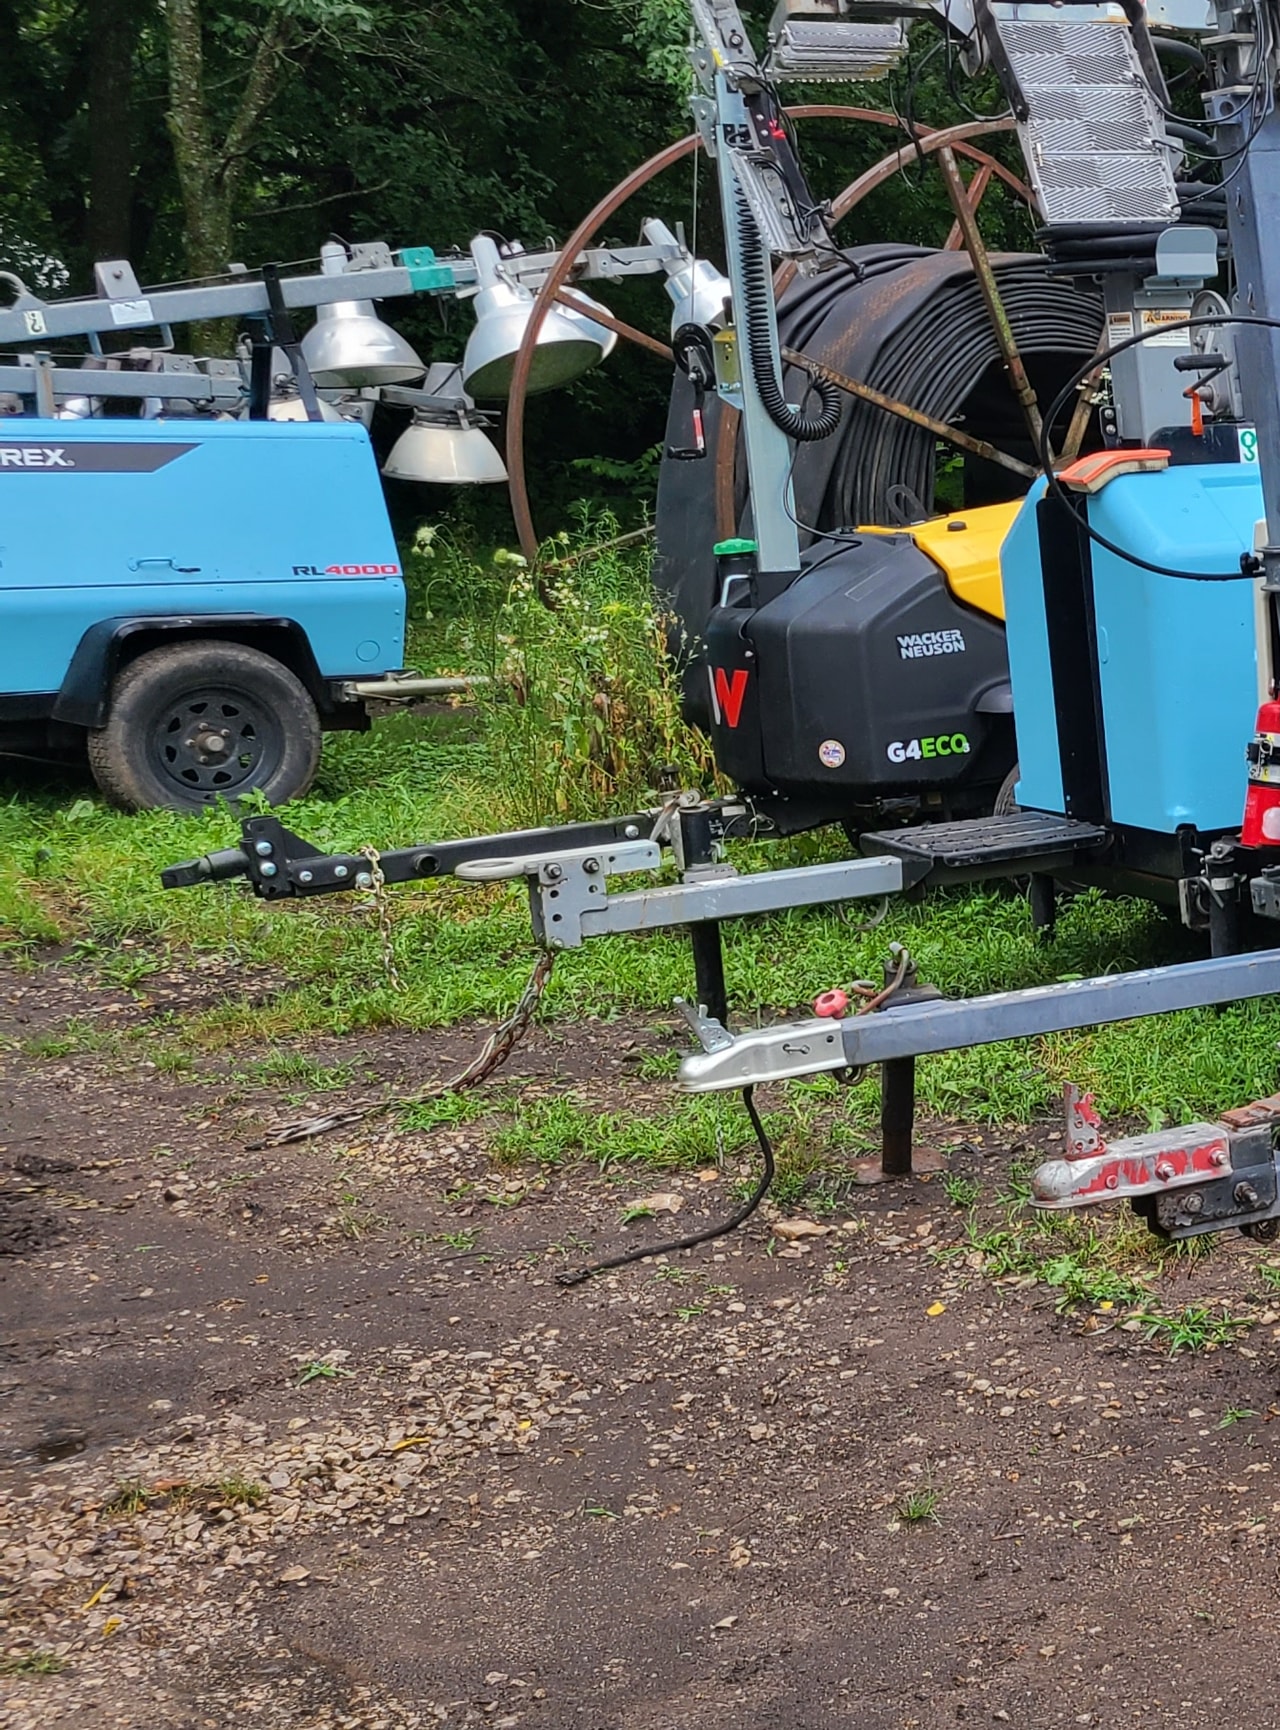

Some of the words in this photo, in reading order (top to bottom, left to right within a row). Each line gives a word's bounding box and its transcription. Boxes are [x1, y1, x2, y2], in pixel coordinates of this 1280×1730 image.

[291, 564, 399, 577] RL4000
[896, 629, 964, 649] WACKER
[900, 639, 966, 660] NEUSON
